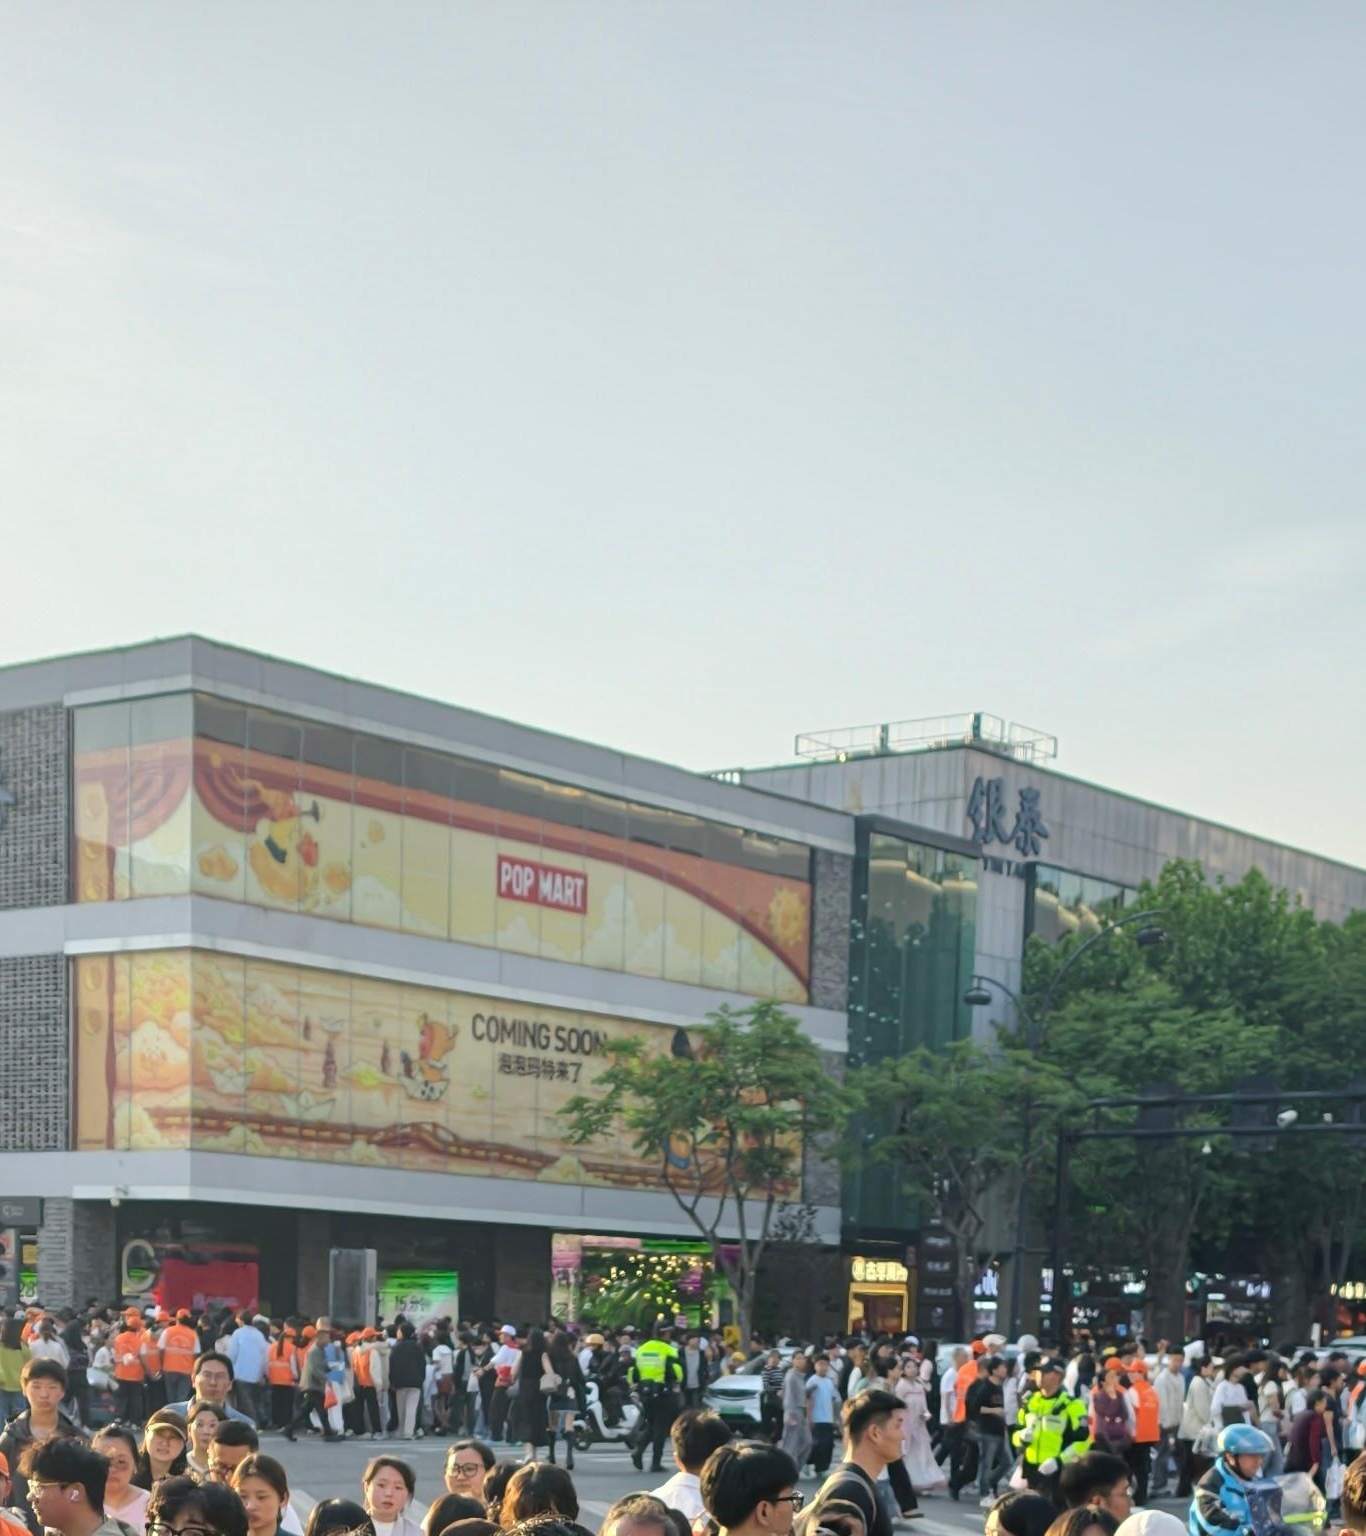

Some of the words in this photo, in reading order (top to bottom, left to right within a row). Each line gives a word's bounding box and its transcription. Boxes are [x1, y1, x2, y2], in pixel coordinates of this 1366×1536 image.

[967, 776, 1049, 857] 银泰
[500, 861, 535, 899] POP
[538, 868, 585, 910] MART
[472, 1013, 551, 1051] COMING
[498, 1052, 583, 1083] 泡泡玛特来了
